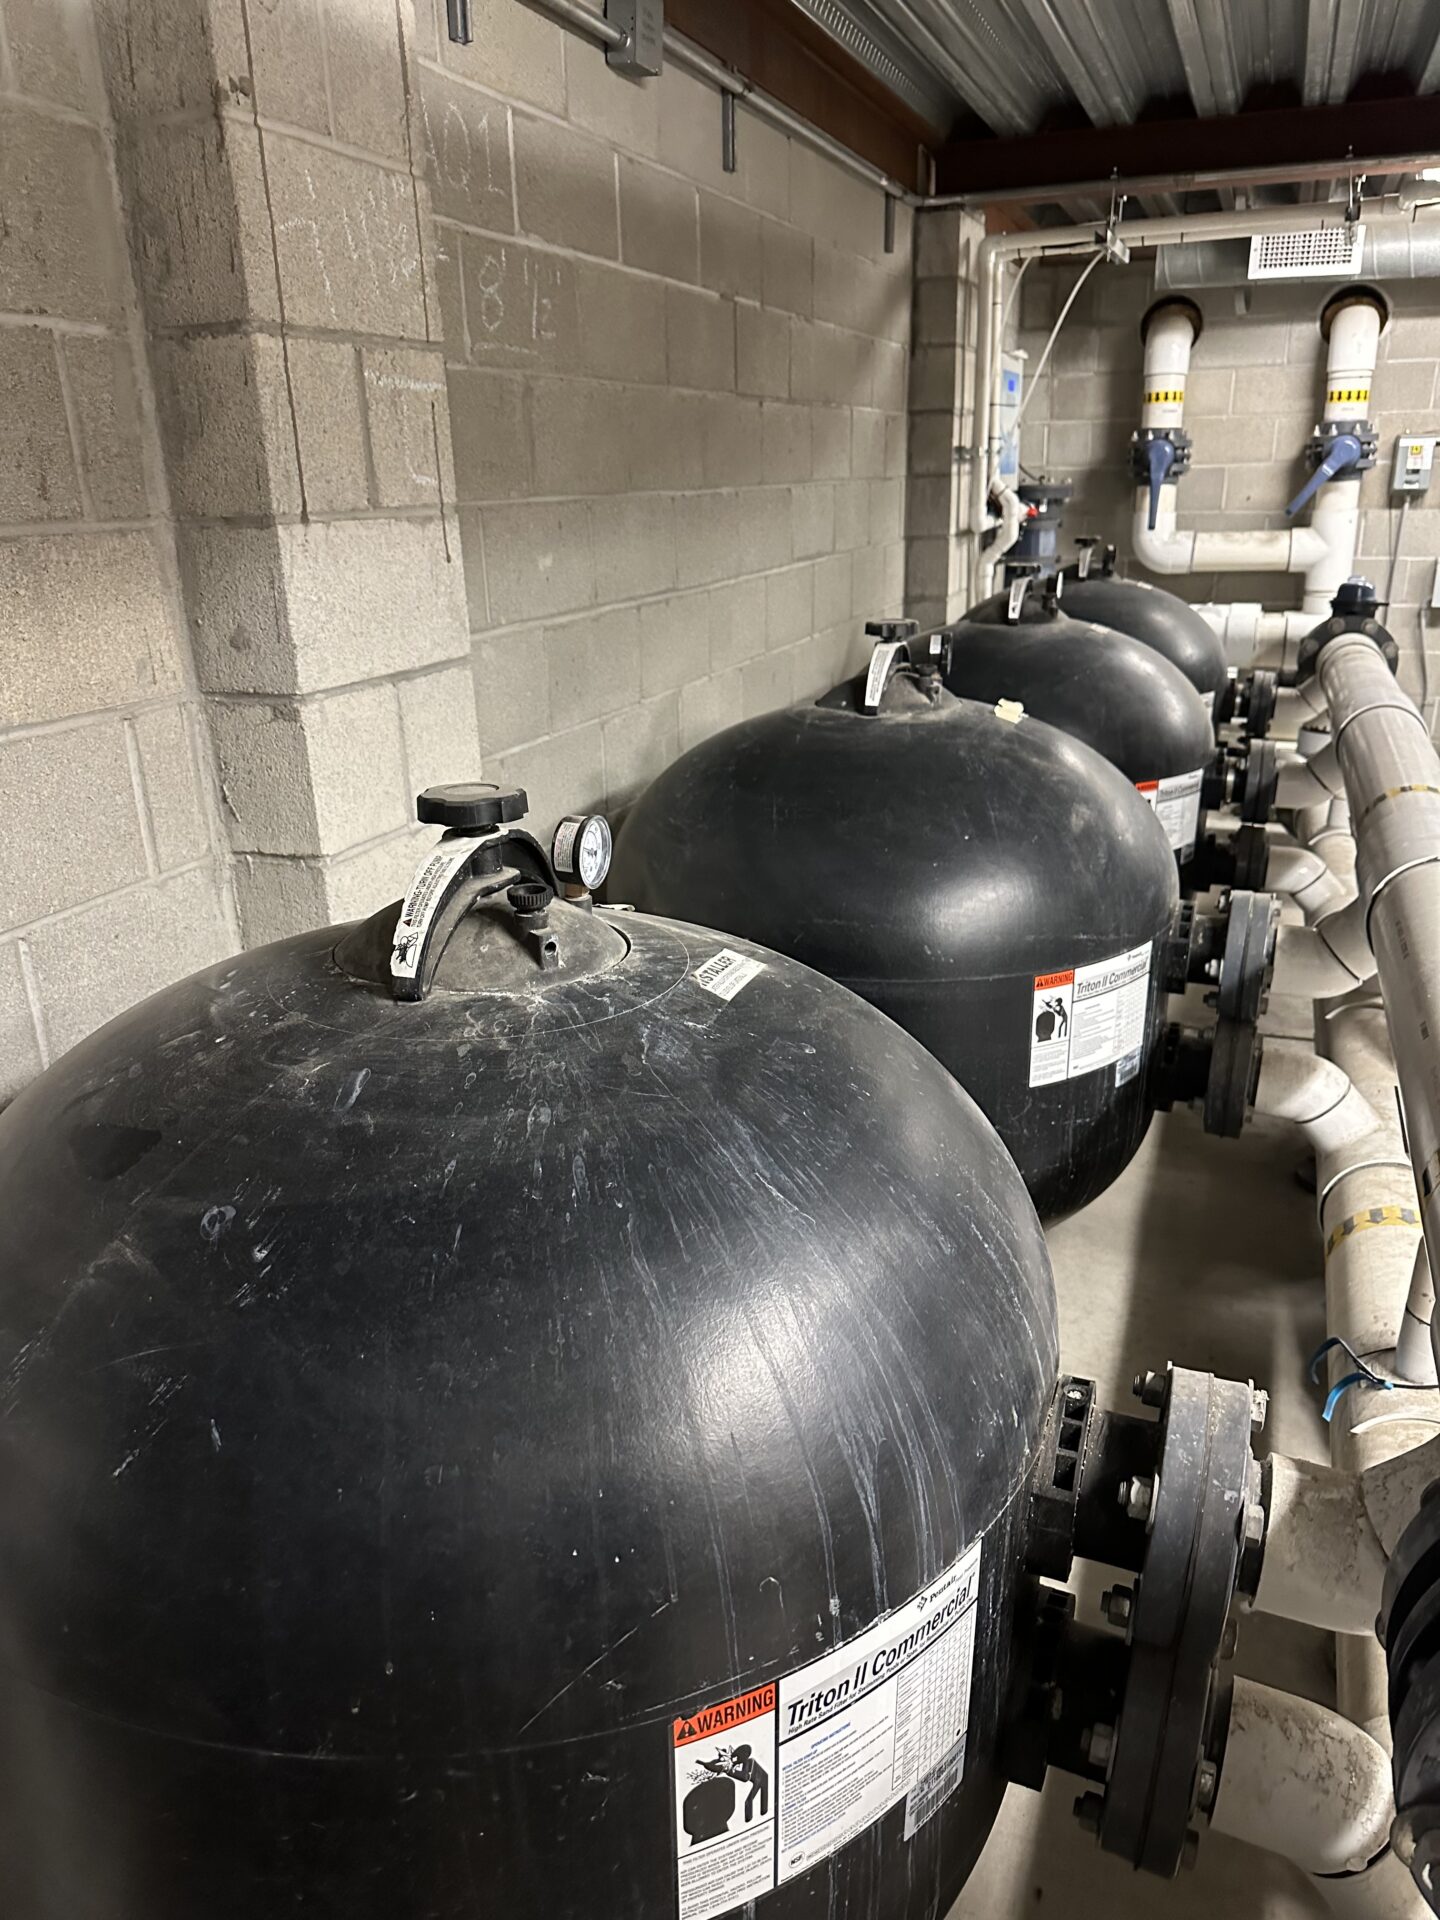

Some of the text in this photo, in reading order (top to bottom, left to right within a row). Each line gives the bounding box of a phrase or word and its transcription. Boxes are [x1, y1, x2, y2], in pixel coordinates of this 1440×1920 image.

[1044, 972, 1073, 986] WARNING
[1077, 959, 1147, 995] Triton II Commercial
[788, 1575, 972, 1726] Triton II Commercial
[697, 1689, 773, 1732] WARNING
[788, 1723, 803, 1736] High
[803, 1715, 817, 1727] Rate
[818, 1705, 832, 1719] Sand
[833, 1696, 847, 1710] Filter
